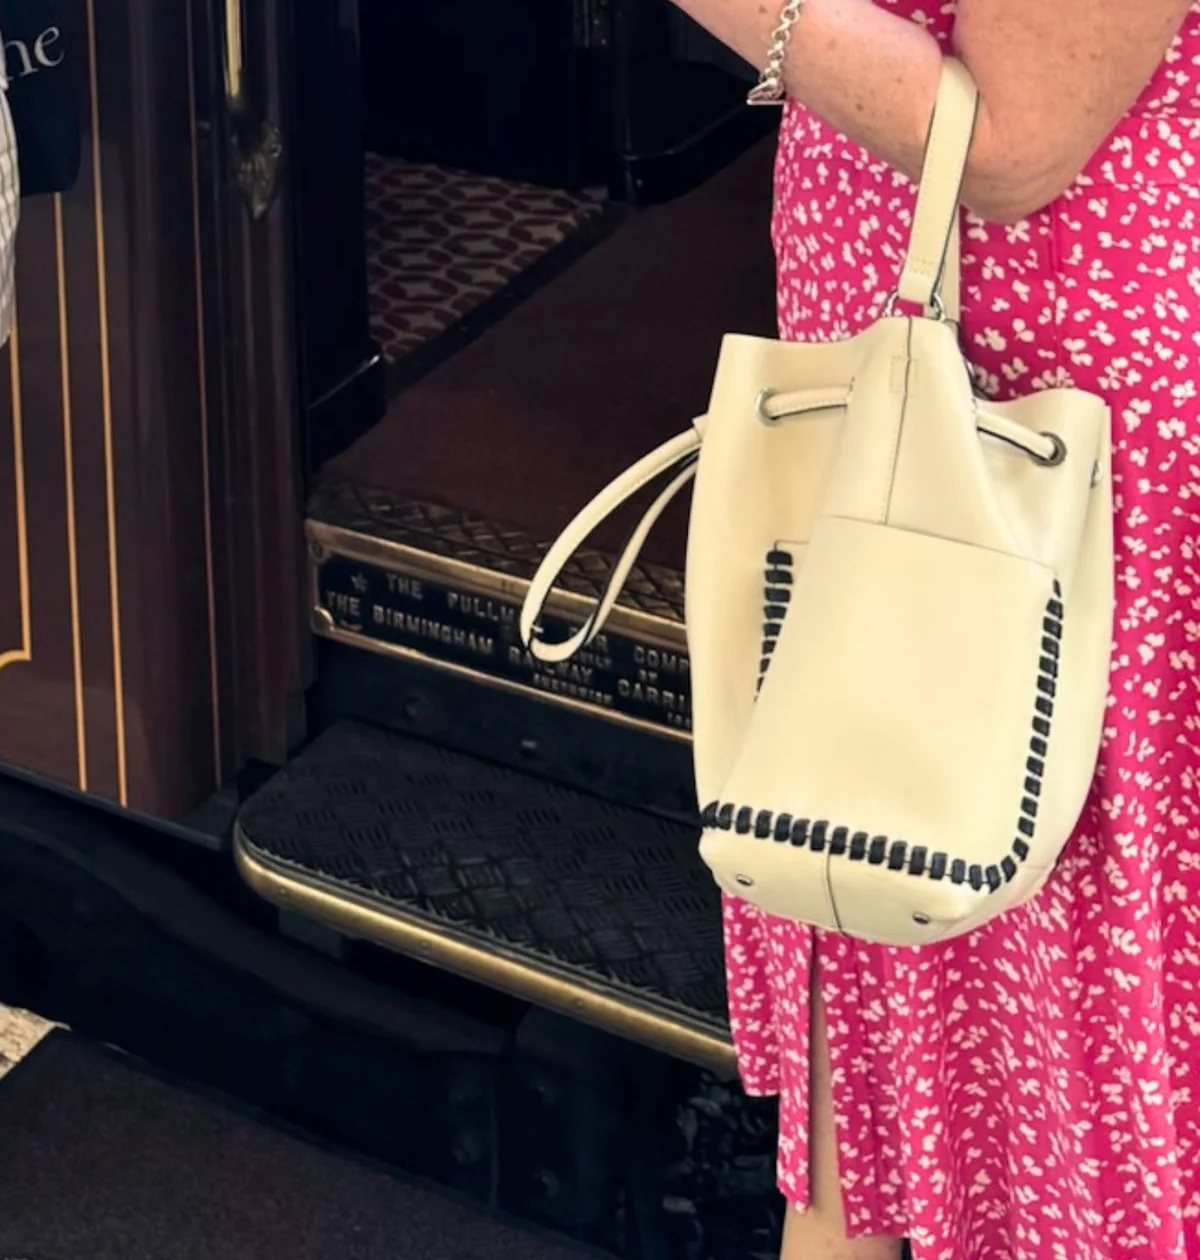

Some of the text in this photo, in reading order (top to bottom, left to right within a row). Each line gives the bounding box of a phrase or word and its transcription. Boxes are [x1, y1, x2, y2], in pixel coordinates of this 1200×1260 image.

[387, 573, 424, 600] THE
[326, 590, 361, 617] THE
[373, 605, 495, 655] BIRMINGHAM
[508, 645, 594, 684] RAWAY
